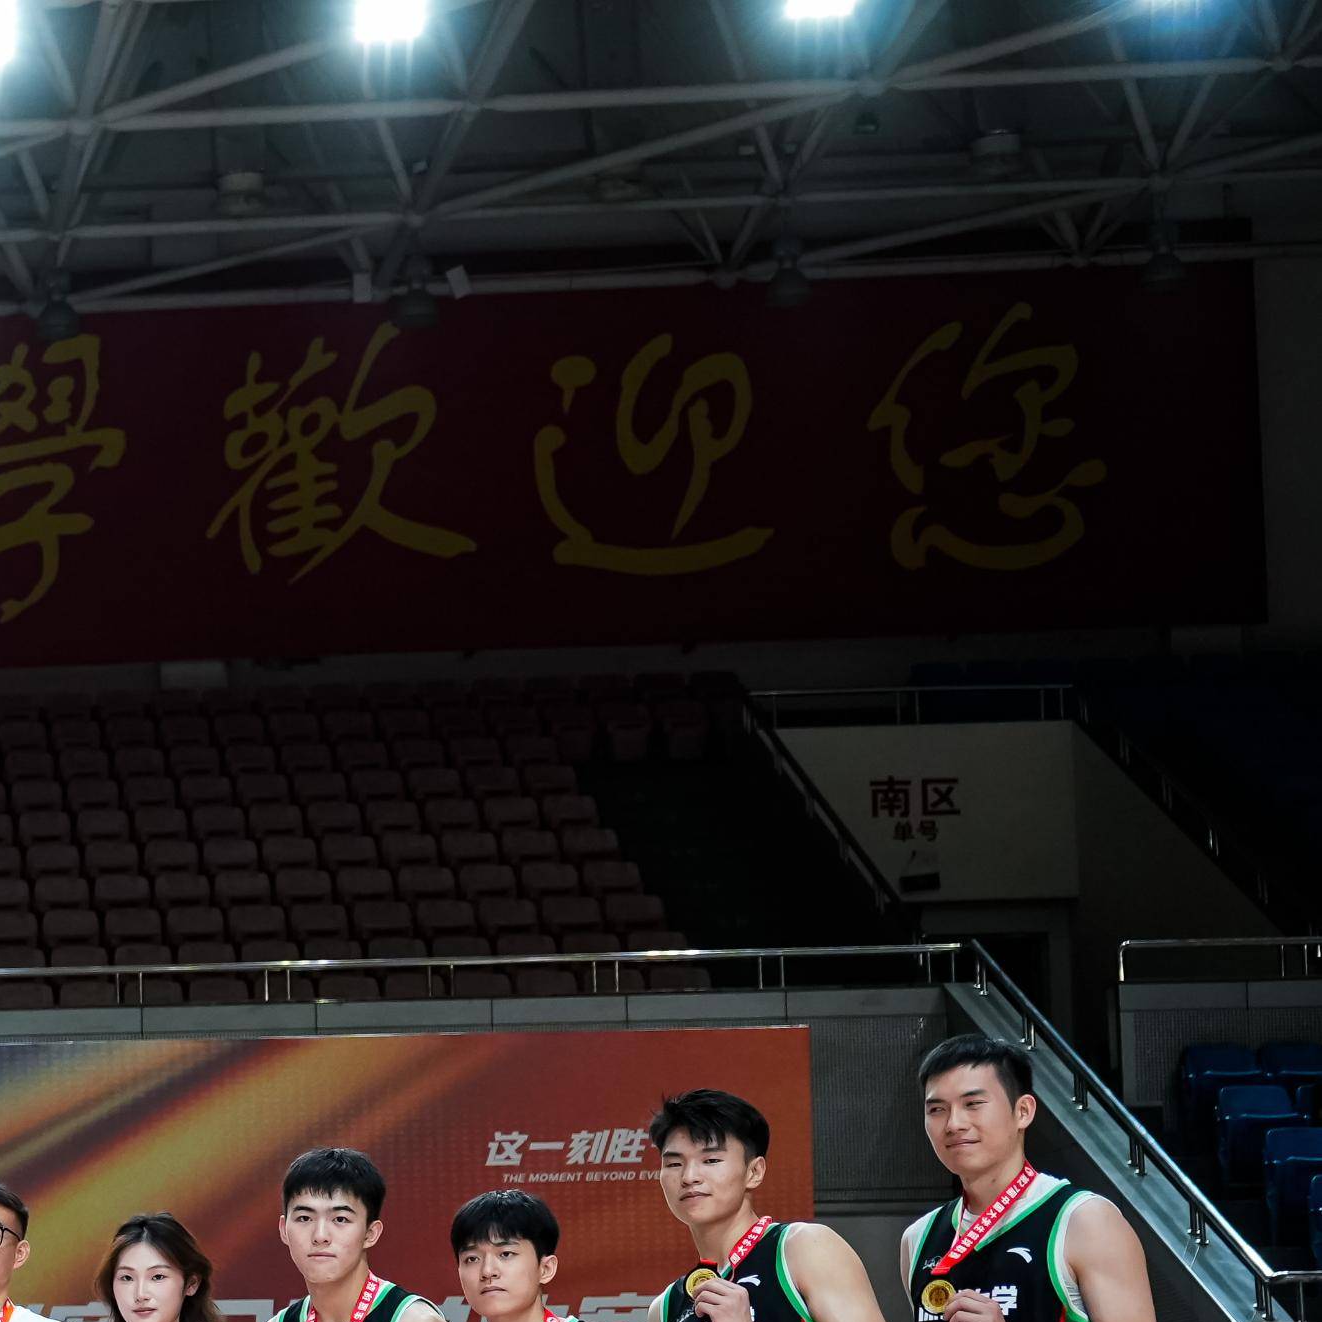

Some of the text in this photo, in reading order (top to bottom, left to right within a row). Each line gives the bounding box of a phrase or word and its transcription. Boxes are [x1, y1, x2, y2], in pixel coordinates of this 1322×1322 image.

[870, 776, 960, 818] 南区
[485, 1128, 659, 1167] 这一刻胜
[503, 1173, 525, 1184] THE
[528, 1172, 583, 1183] MOMENT
[586, 1171, 636, 1182] BEYOND
